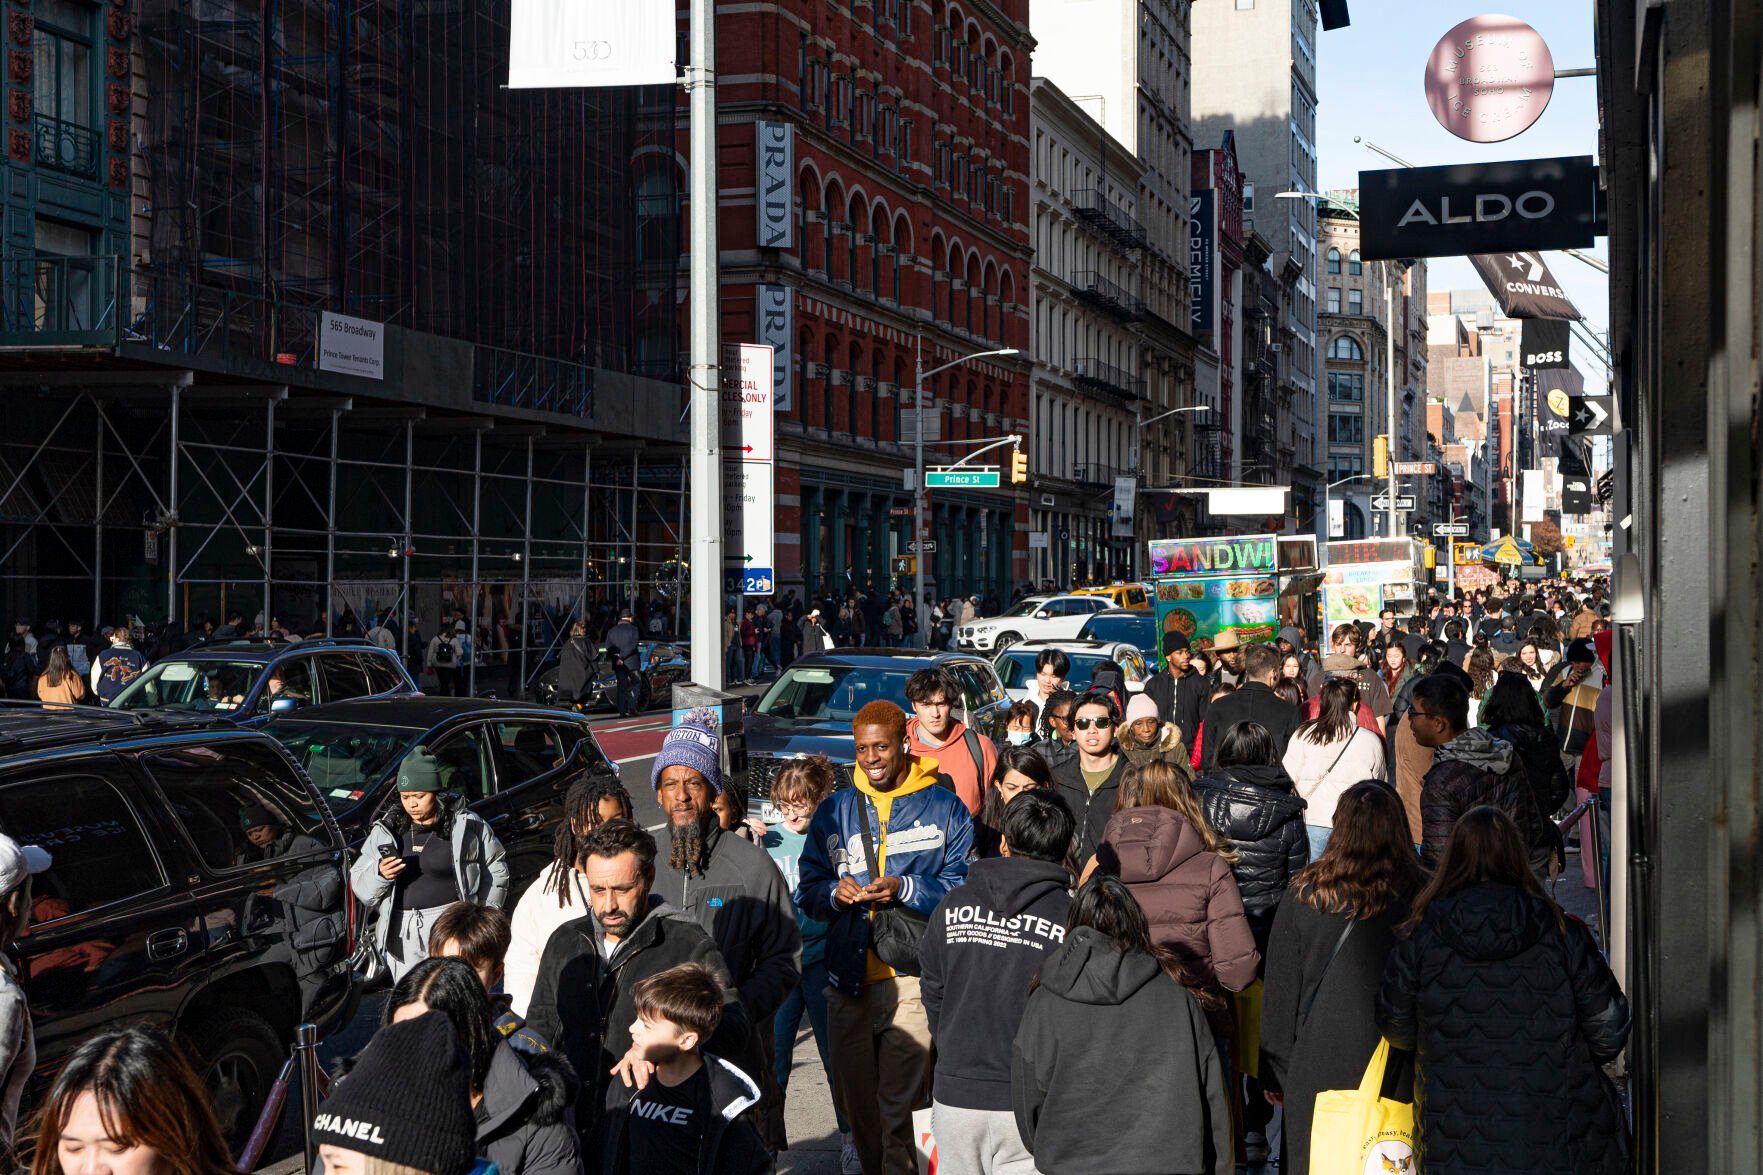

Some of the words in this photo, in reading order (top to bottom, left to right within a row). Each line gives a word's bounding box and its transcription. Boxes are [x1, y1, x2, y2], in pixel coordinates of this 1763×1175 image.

[1444, 34, 1512, 72] MUSEUM
[1448, 94, 1472, 119] ICE
[764, 120, 786, 247] PRADA
[1397, 190, 1556, 227] ALDO
[330, 320, 342, 332] 565
[344, 323, 376, 341] Broadway
[324, 349, 338, 358] Prince
[339, 352, 352, 361] Tower
[353, 354, 368, 363] Tenants
[369, 357, 380, 366] Corp.
[1526, 350, 1562, 365] BOSS
[746, 394, 766, 403] ONLY
[1399, 464, 1422, 473] PRINCE
[1424, 463, 1432, 473] ST
[945, 905, 1066, 944] HOLLISTER
[946, 924, 974, 932] SOUTHERN
[974, 924, 1009, 936] CALIFORNIA
[992, 933, 1023, 944] DESIGNED
[1030, 941, 1044, 950] USA
[630, 1098, 694, 1126] NIKE
[314, 1113, 385, 1146] CHANEL
